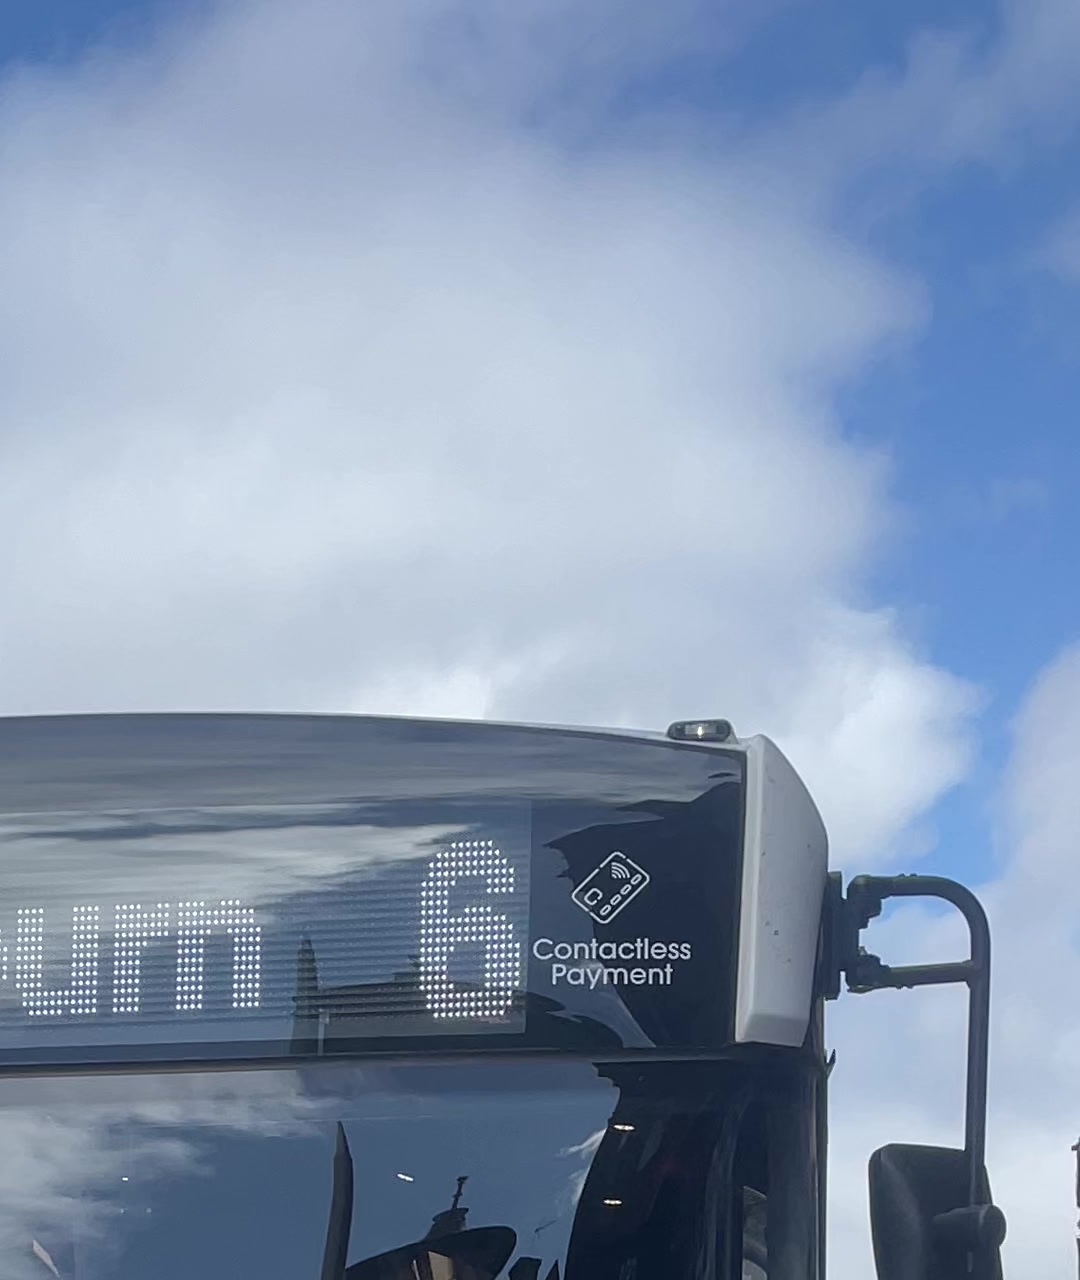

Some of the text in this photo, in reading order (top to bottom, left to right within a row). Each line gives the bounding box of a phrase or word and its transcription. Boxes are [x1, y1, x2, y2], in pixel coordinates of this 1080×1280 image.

[419, 838, 522, 1020] 6
[532, 937, 692, 962] Contactless
[551, 963, 675, 987] Payment
